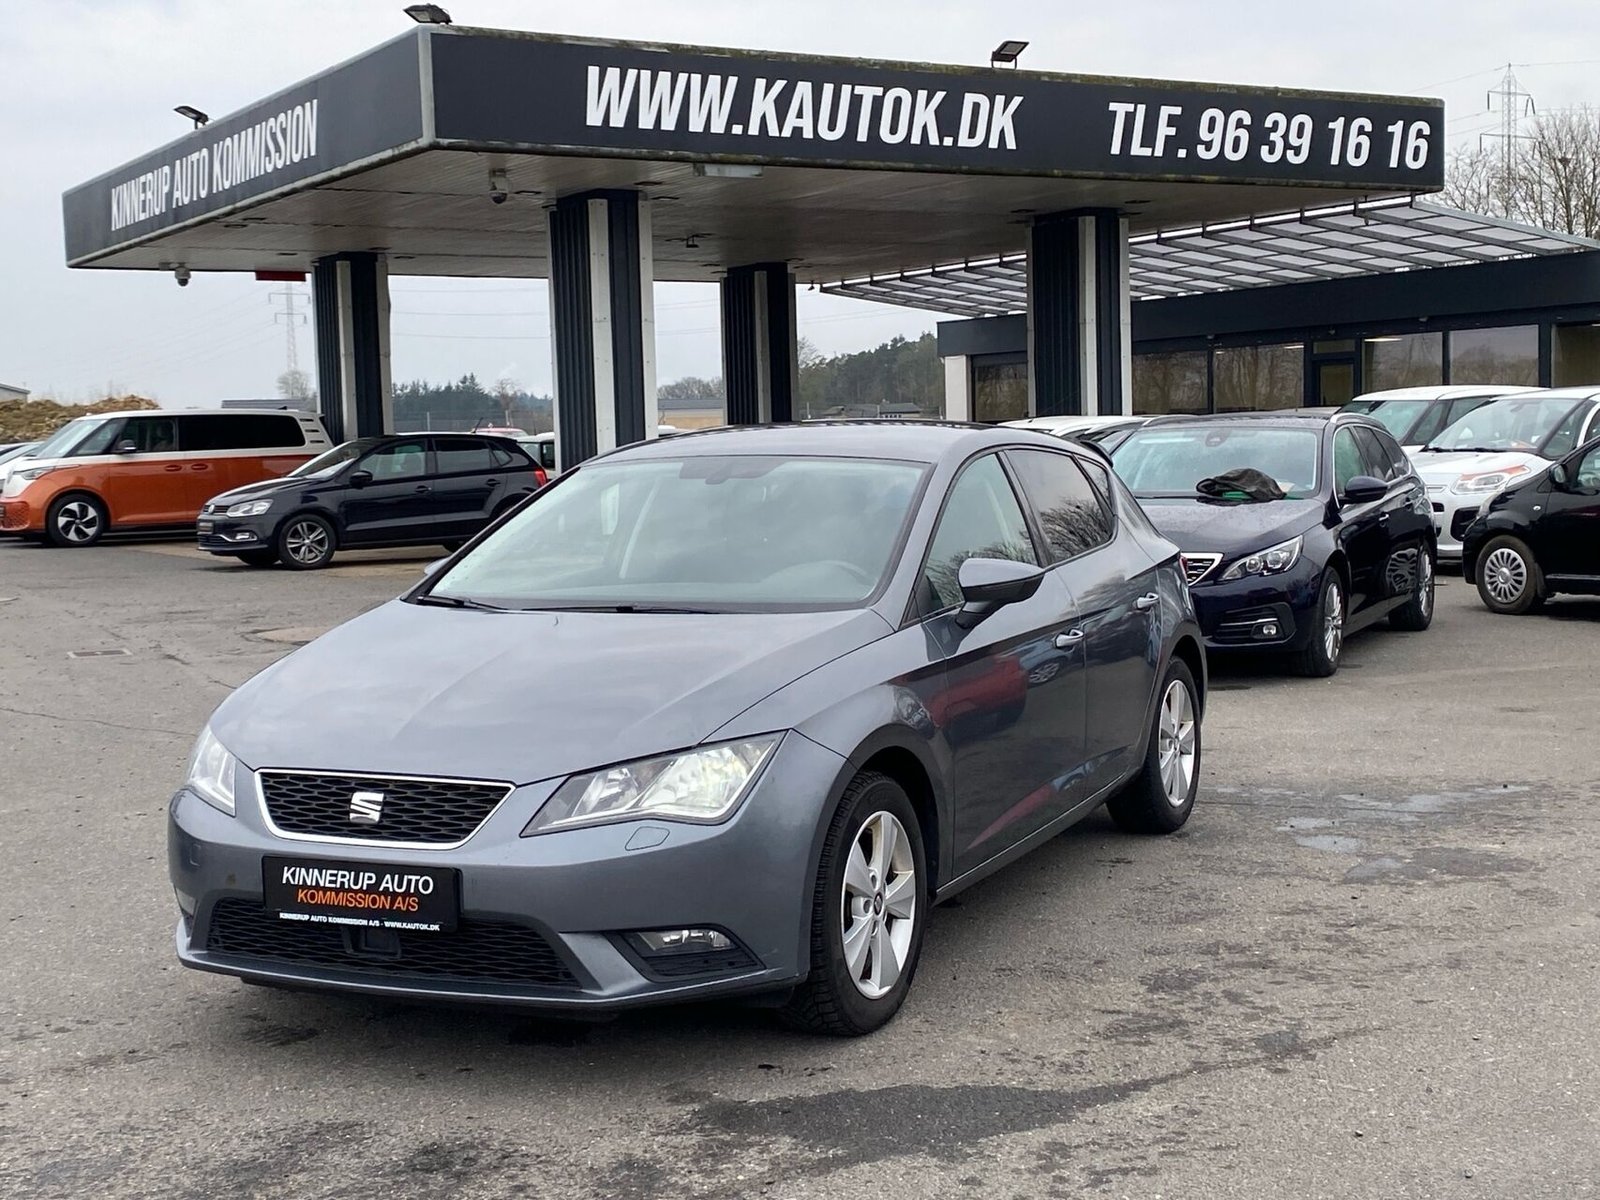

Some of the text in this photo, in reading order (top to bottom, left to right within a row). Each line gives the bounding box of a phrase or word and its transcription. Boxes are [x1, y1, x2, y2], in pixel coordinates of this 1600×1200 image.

[585, 65, 1025, 151] WWW.KAUTOK.DK
[1108, 101, 1431, 170] TLF. 96 39 16 16
[111, 98, 318, 232] KINNERUP AUTO KOMMISSION
[281, 866, 434, 895] KINNERUP AUTO
[297, 888, 419, 912] KOMMISSION A/S
[279, 912, 310, 921] KINNERUP
[310, 914, 328, 923] AUTO
[328, 916, 368, 926] KOMMISSION
[368, 918, 380, 927] A/S
[384, 920, 440, 931] WWW.KAUTOK.DK
